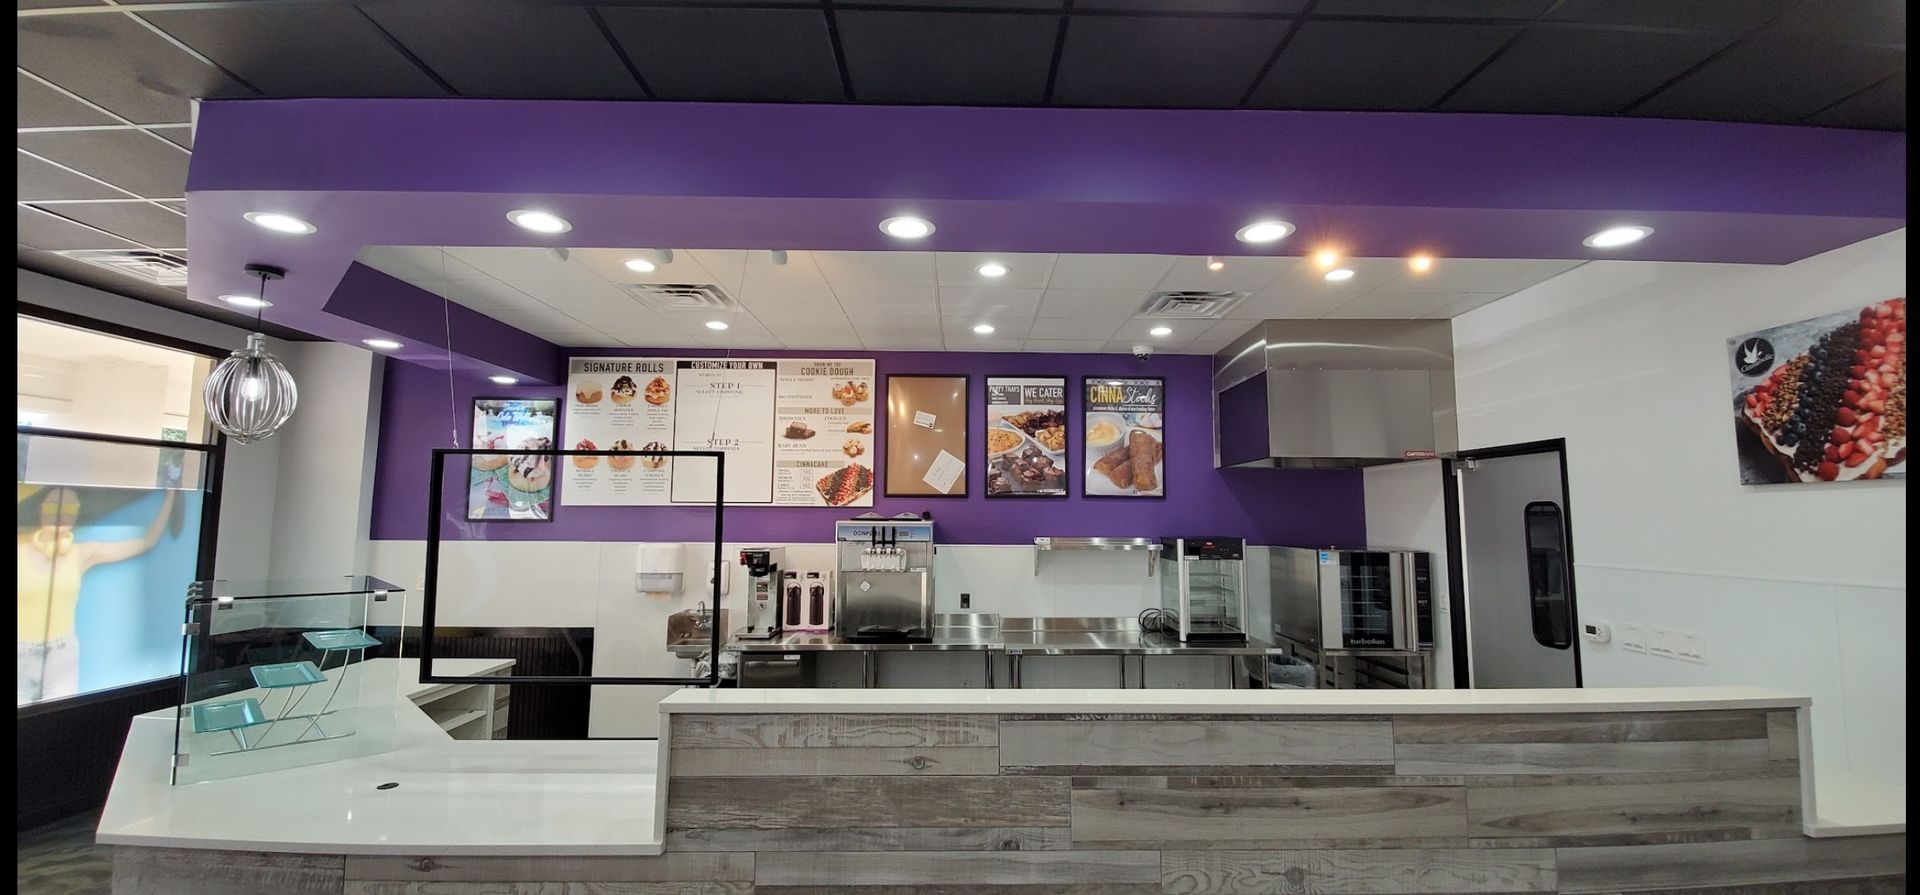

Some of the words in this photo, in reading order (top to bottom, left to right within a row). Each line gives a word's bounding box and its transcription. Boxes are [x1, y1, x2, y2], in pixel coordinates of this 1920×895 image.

[584, 362, 634, 373] SIGNATURE
[636, 363, 664, 373] ROLLS
[691, 361, 727, 369] CUSTOMIZE
[730, 362, 746, 370] YOUR
[748, 362, 764, 370] OWN
[801, 367, 827, 375] COOKIE
[1024, 387, 1037, 397] WE
[1039, 387, 1063, 398] CATER
[1090, 386, 1123, 403] CINNA
